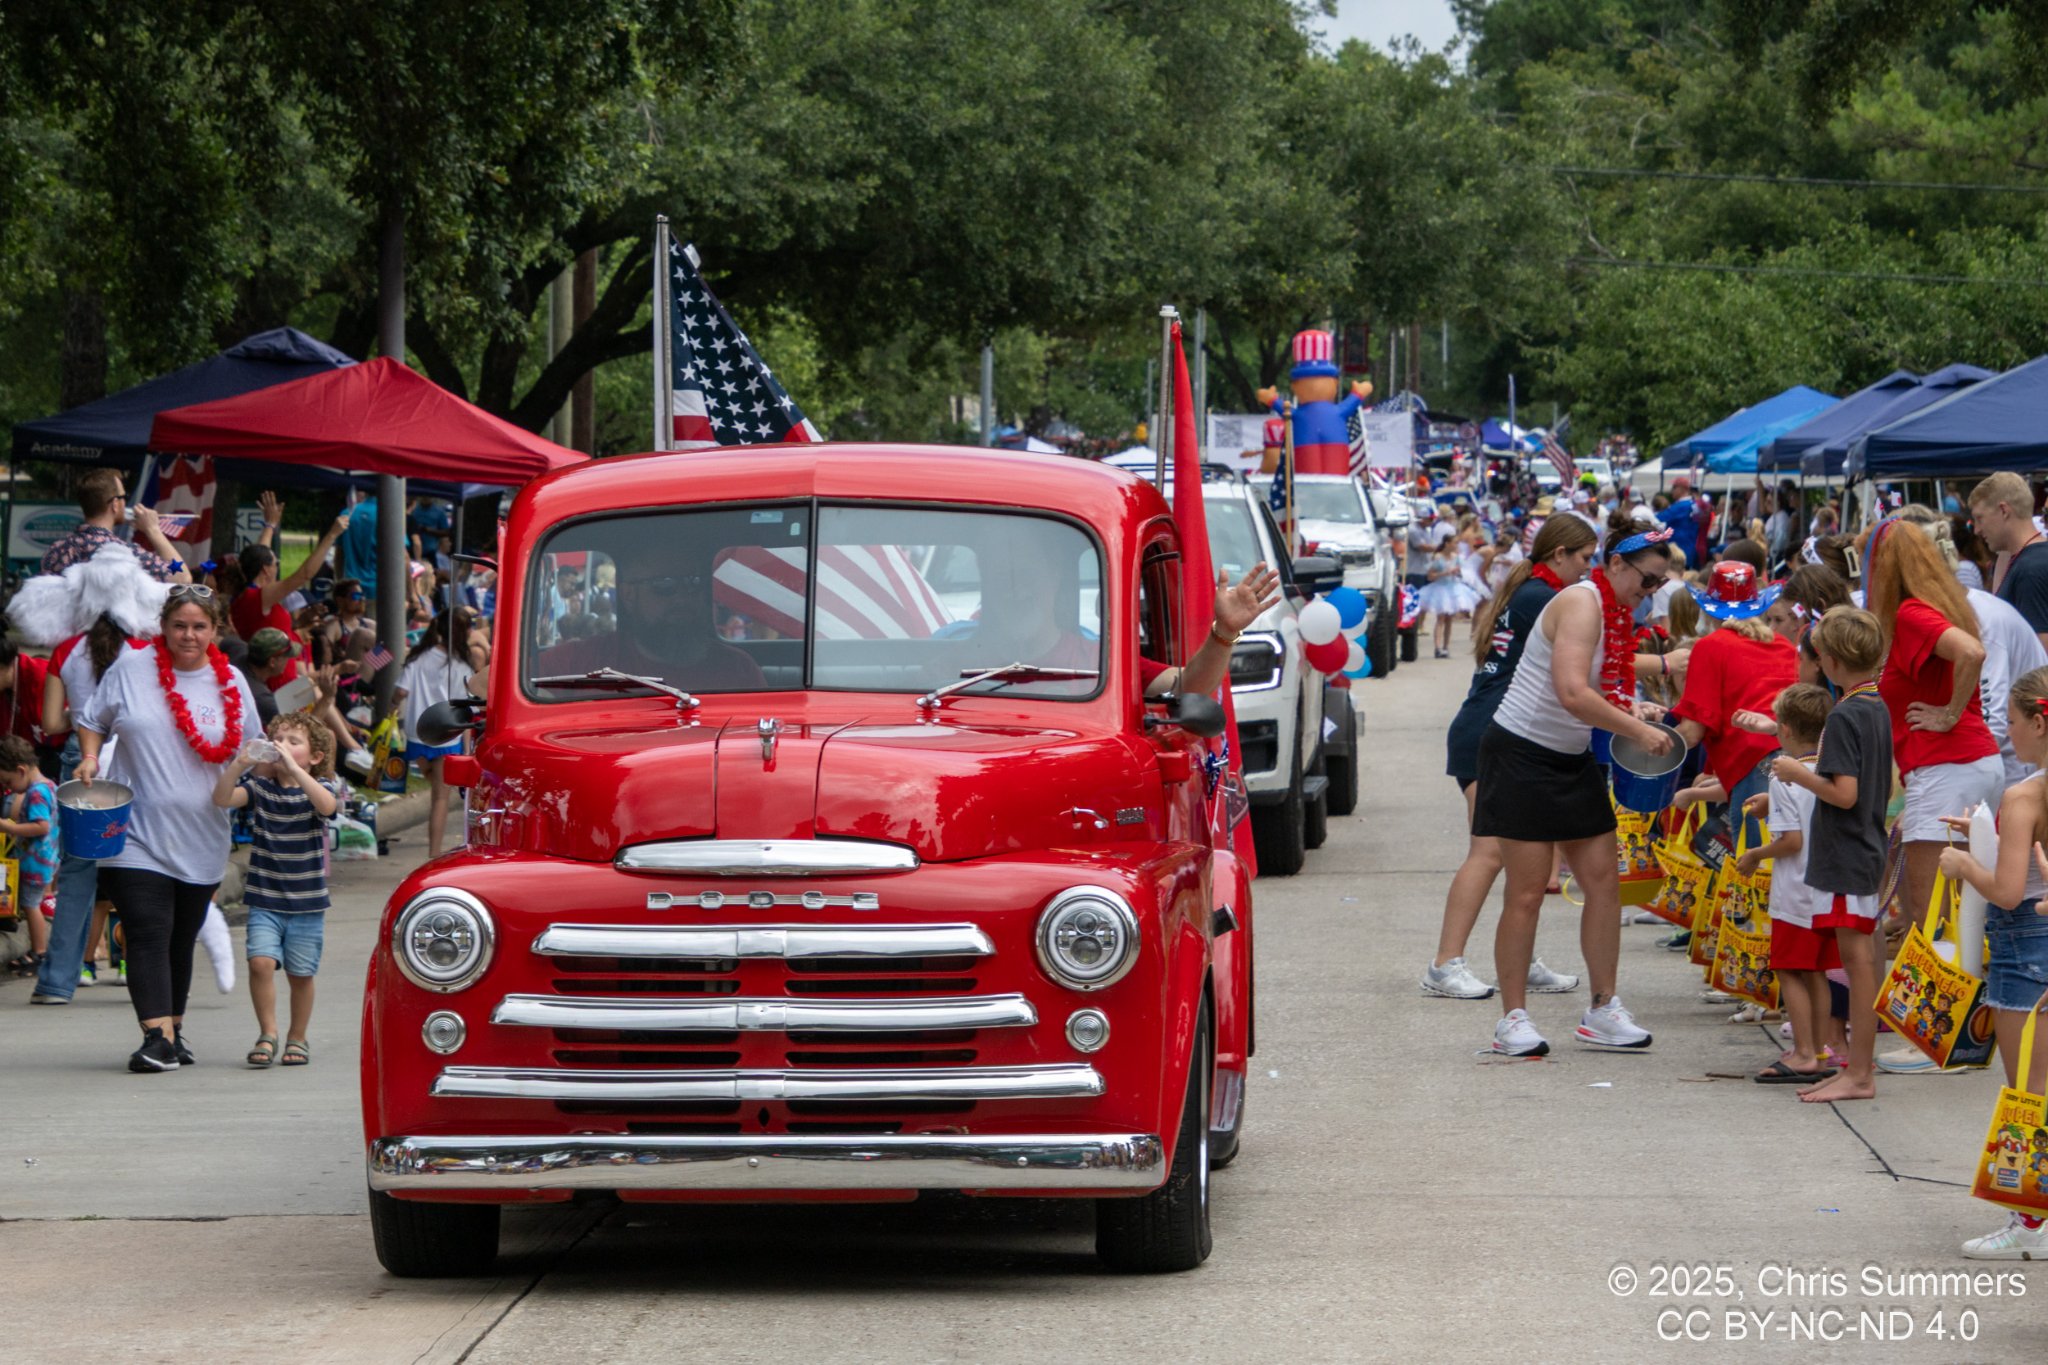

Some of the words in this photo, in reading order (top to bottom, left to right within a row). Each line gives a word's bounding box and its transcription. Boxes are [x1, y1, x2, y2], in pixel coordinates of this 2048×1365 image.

[31, 442, 103, 458] Academy
[646, 890, 880, 910] DODGE
[1938, 963, 1957, 977] BUDDY
[1935, 971, 1969, 1002] HERO
